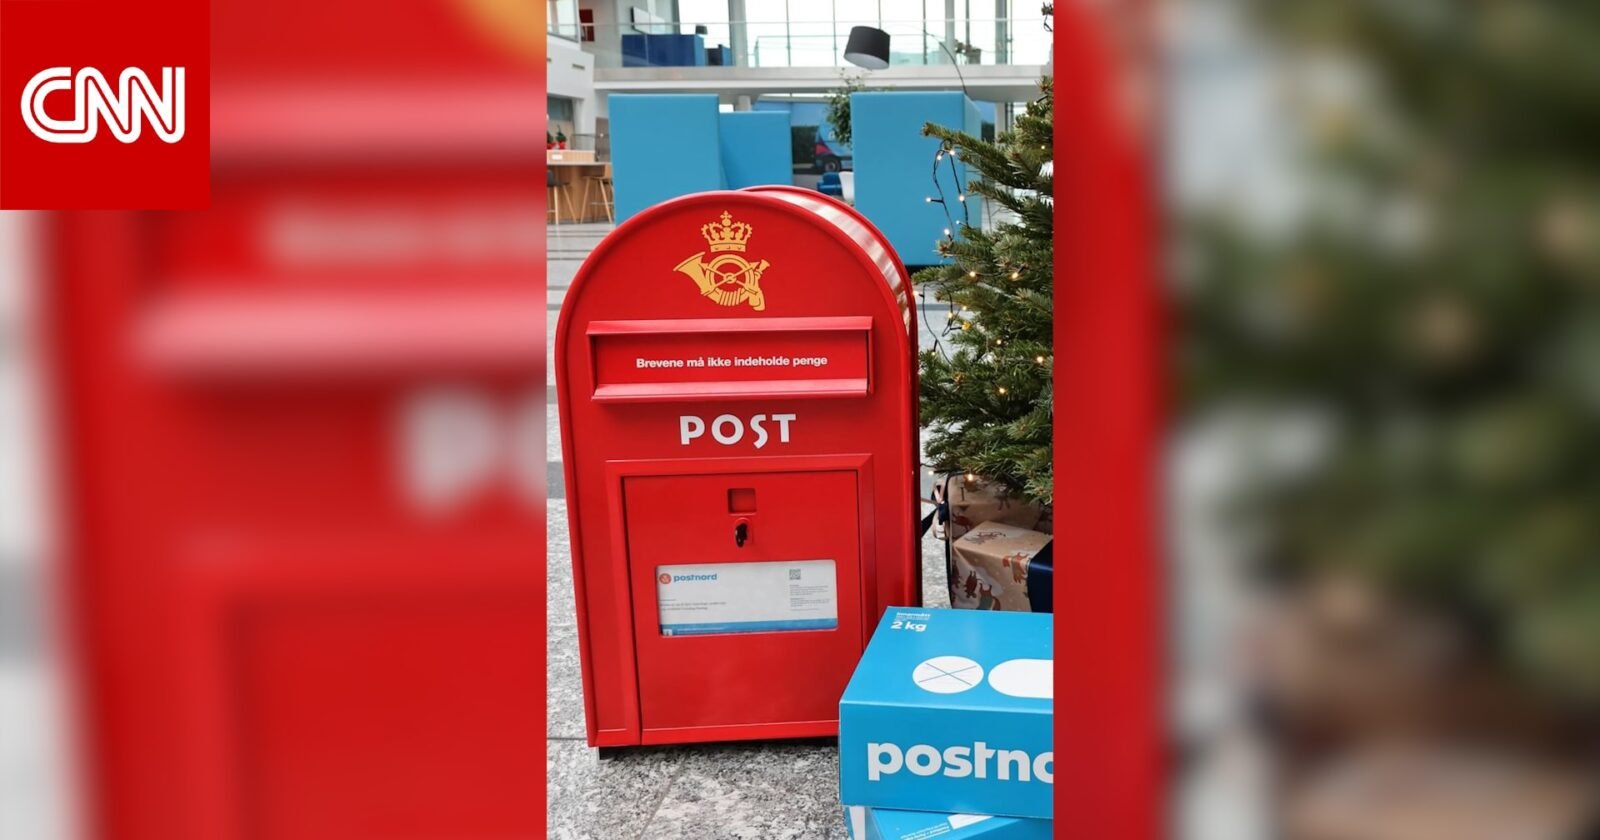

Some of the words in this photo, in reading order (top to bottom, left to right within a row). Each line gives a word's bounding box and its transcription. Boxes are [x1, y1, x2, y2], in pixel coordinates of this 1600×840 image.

[636, 358, 684, 369] Brevene
[686, 356, 705, 367] må
[707, 357, 731, 367] ikke
[734, 355, 790, 367] indeholde
[792, 356, 828, 367] penge
[679, 413, 797, 449] POST
[673, 573, 718, 583] postnord
[890, 621, 903, 630] 2
[904, 621, 927, 632] kg
